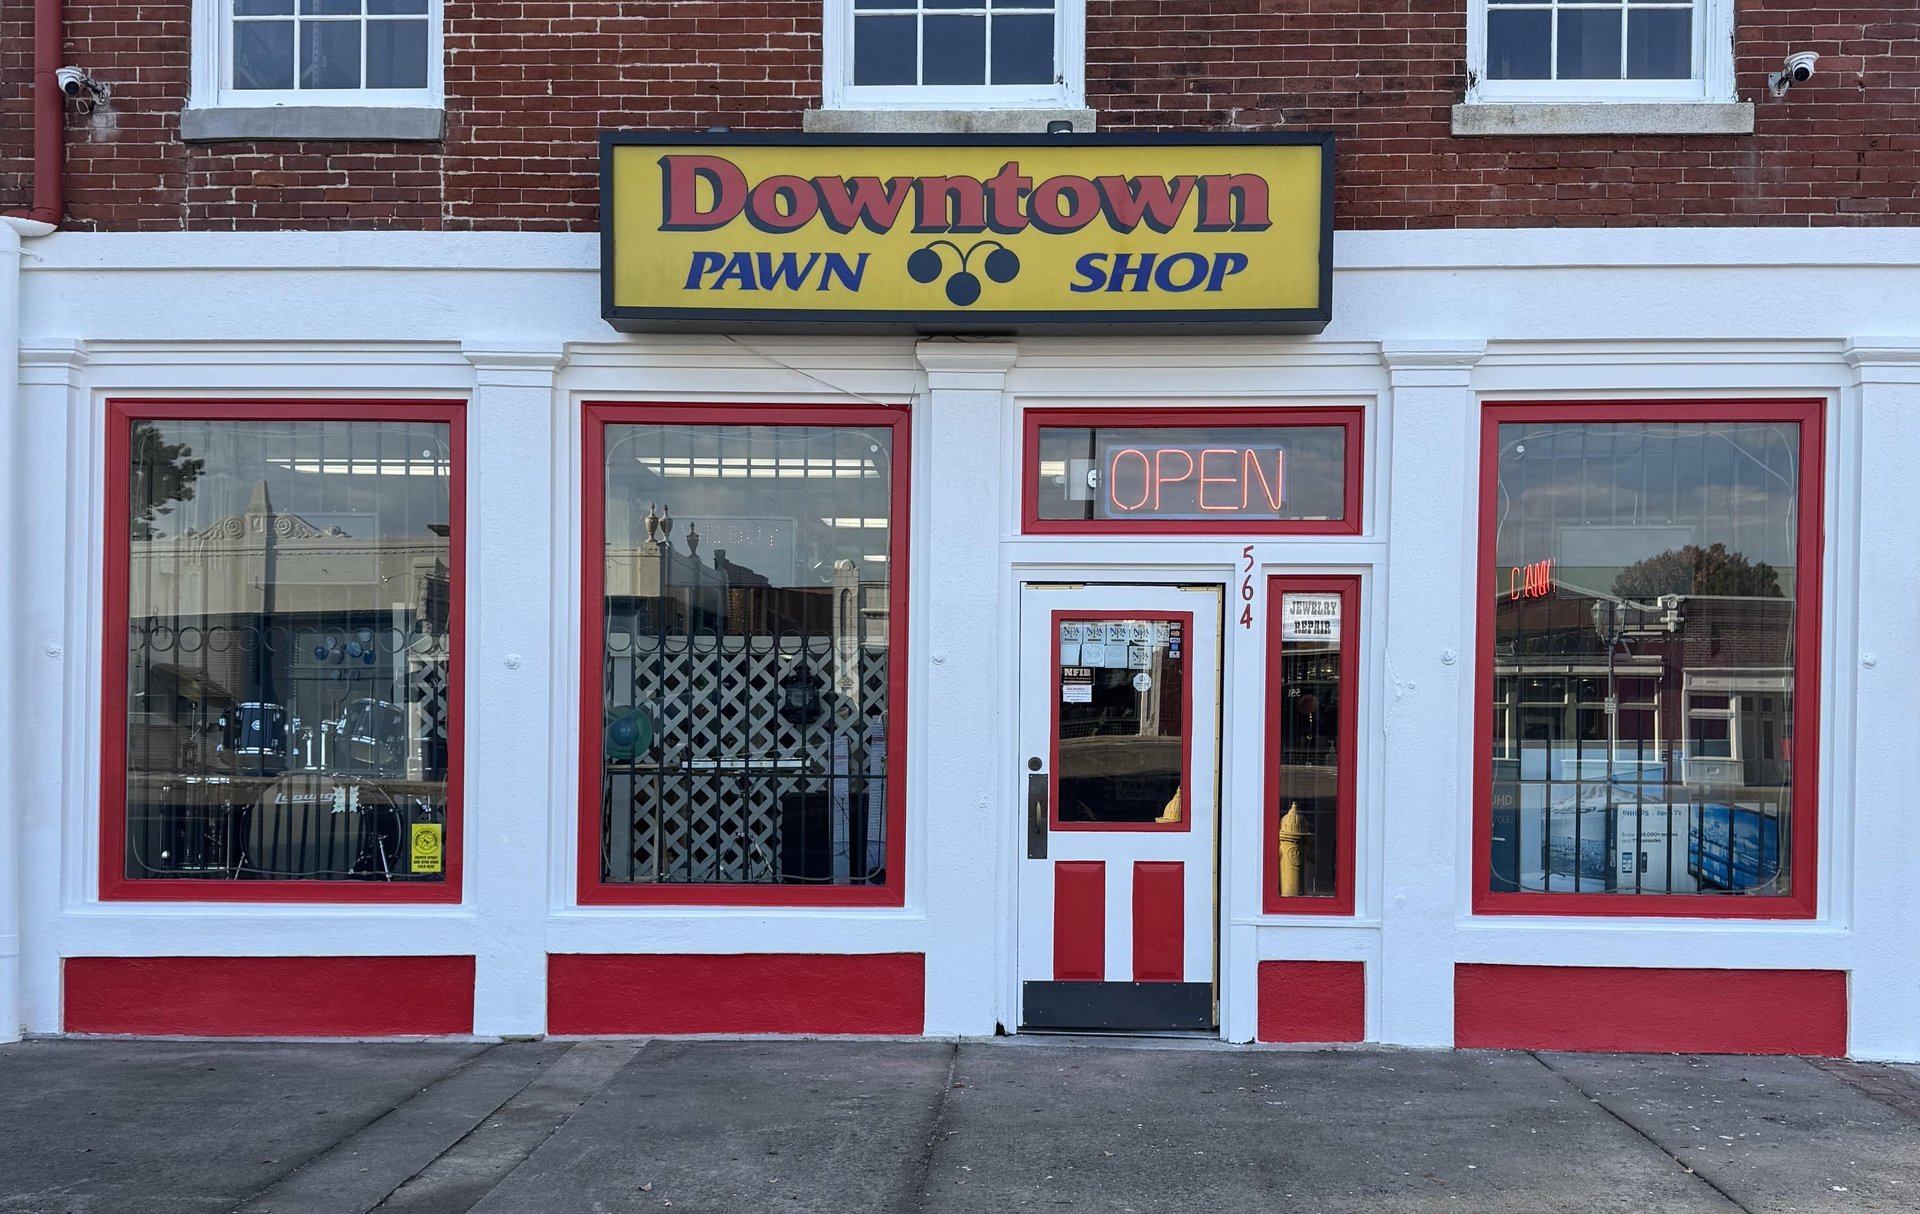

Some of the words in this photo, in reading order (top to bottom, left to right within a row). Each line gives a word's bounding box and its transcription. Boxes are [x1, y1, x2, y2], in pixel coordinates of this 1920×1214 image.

[657, 155, 1273, 235] Downtown
[682, 251, 870, 292] PAWN
[1070, 252, 1249, 292] SHOP
[1111, 448, 1283, 511] OPEN
[1239, 545, 1254, 629] 564
[1289, 601, 1337, 615] JEWELRY
[1294, 620, 1331, 635] REPAIR
